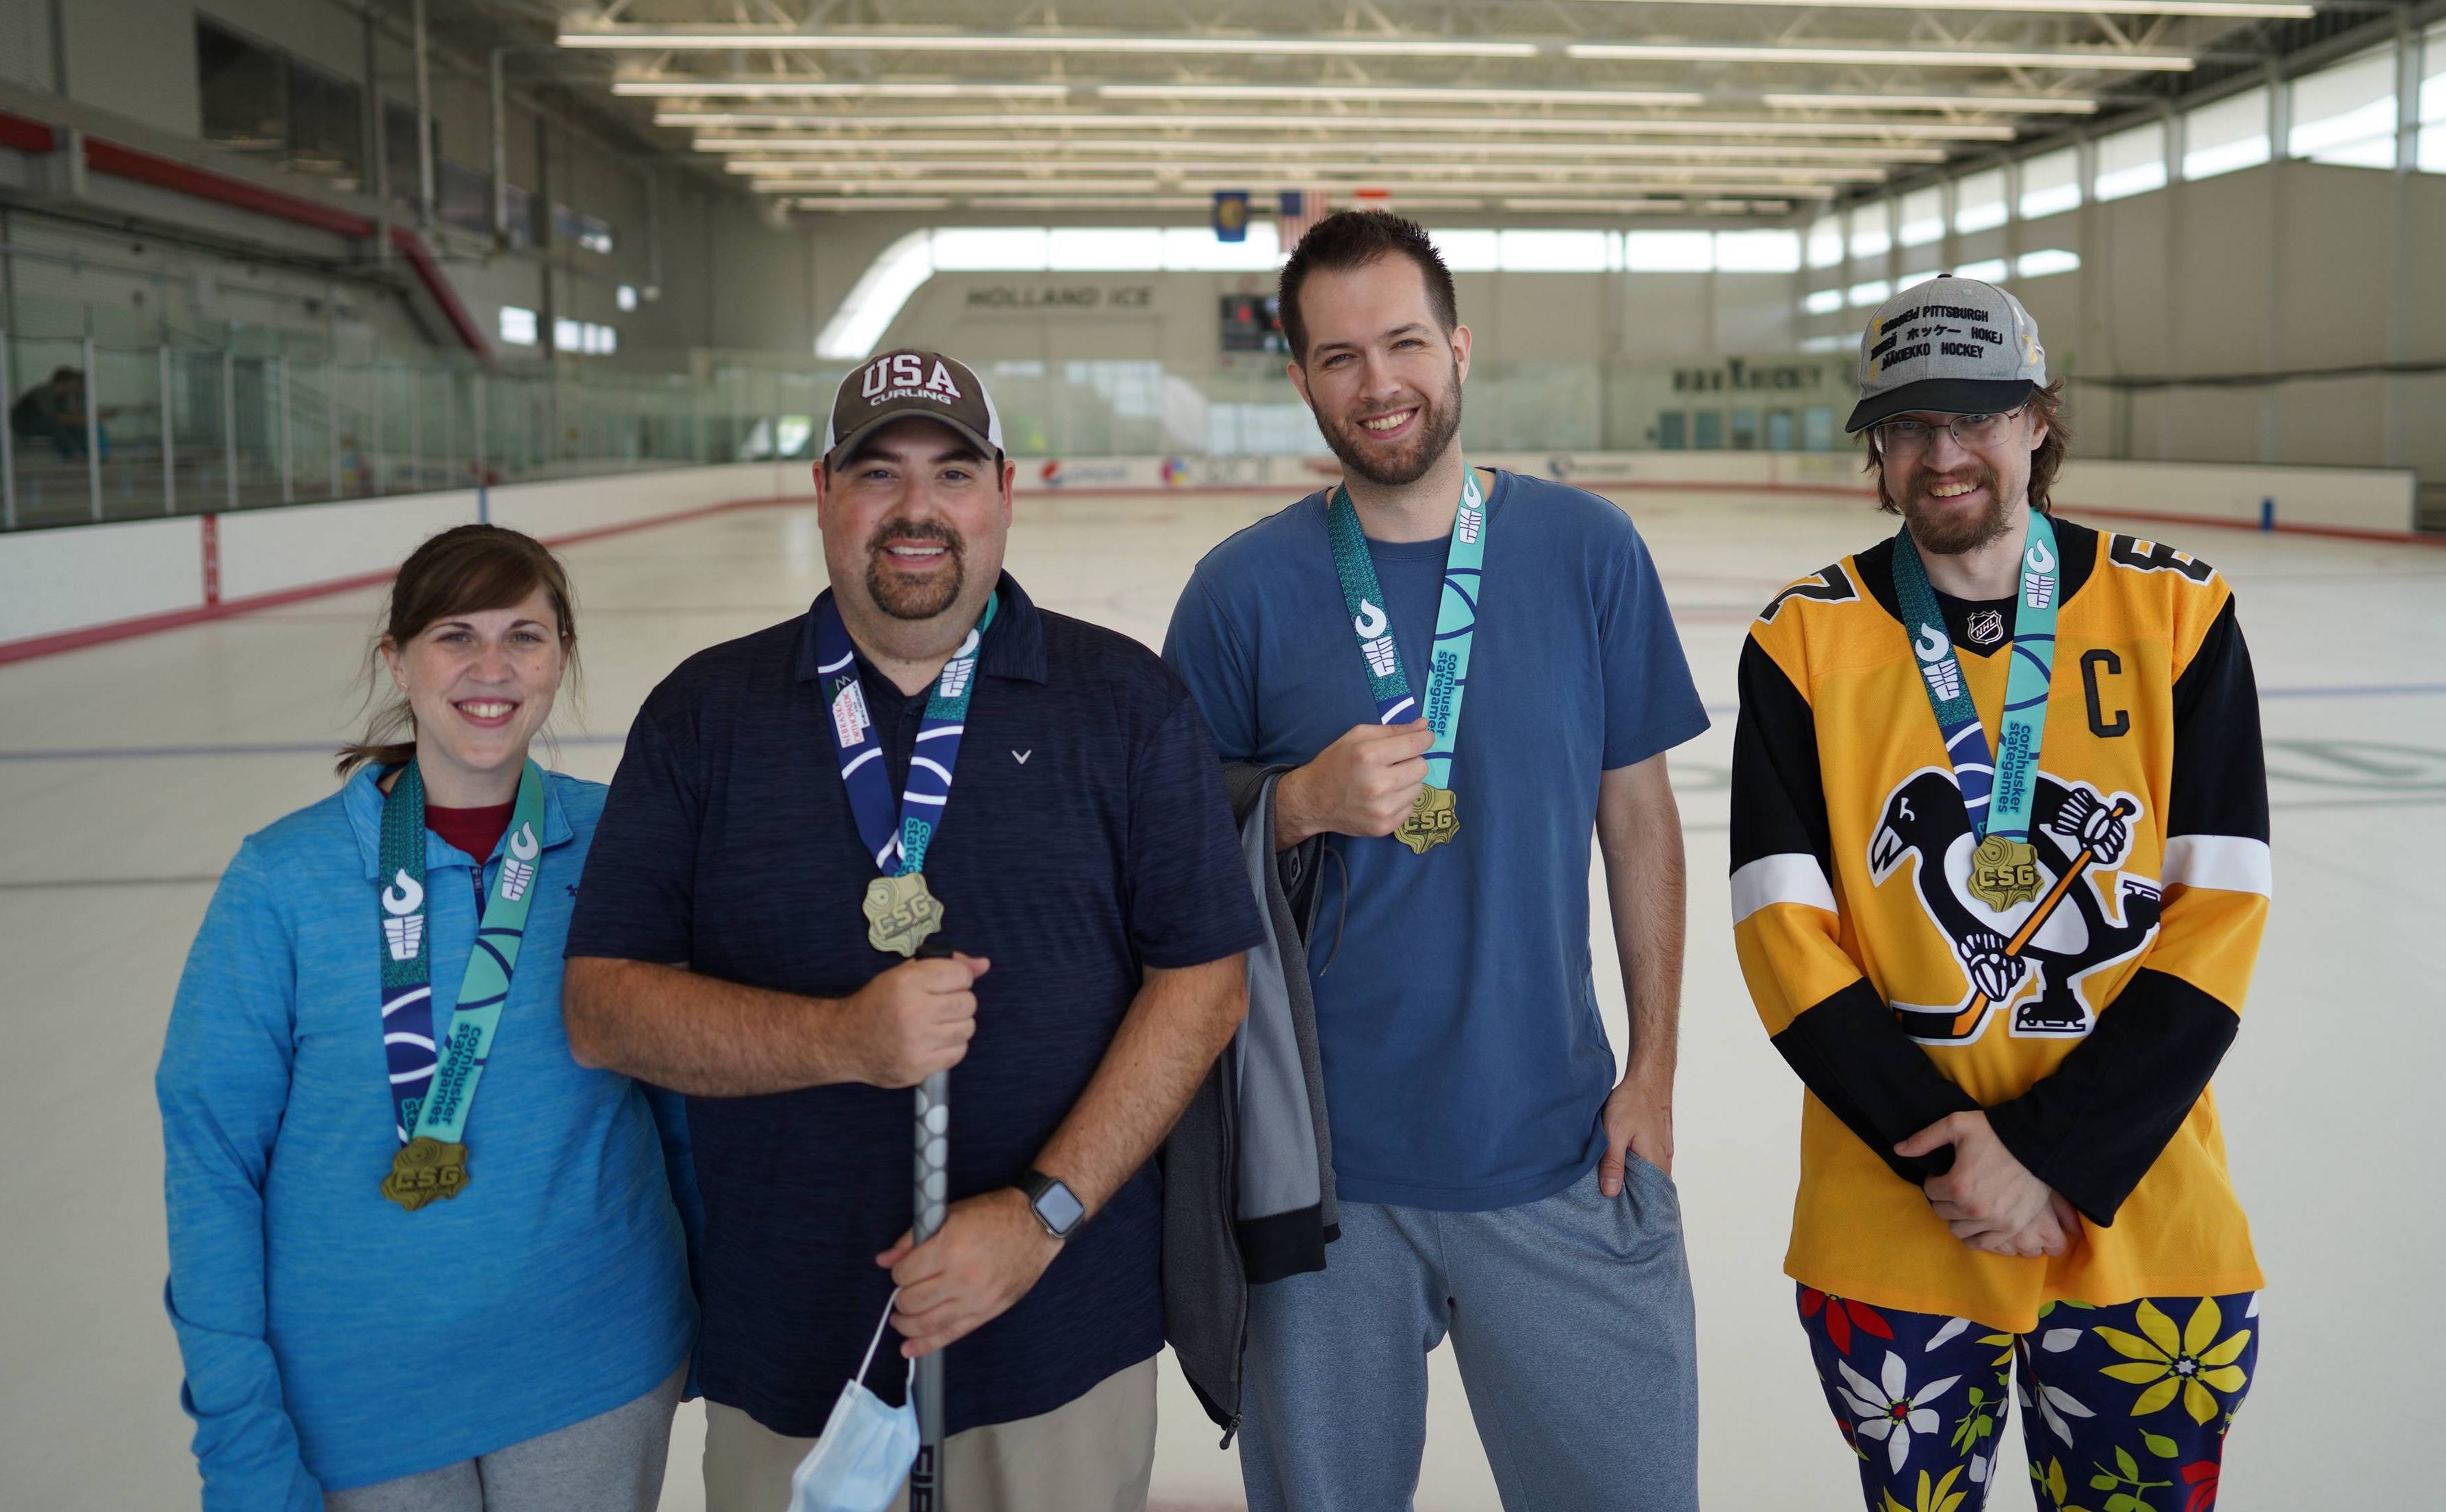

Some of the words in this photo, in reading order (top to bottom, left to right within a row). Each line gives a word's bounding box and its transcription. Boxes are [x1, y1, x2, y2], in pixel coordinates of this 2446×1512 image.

[966, 286, 1103, 308] HOLLAND
[1107, 286, 1153, 308] ICE
[1922, 305, 1989, 322] PITTSBURGH
[1907, 324, 1961, 341] ホッケー
[1971, 326, 2003, 345] HOKEJ
[1941, 342, 1984, 359] HOCKEY
[861, 353, 962, 399] USA
[870, 388, 951, 406] CURLING
[1976, 619, 1996, 637] NHL
[1437, 654, 1457, 735] cornhusker
[2080, 649, 2130, 738] C
[835, 701, 851, 746] NEBRASKA
[1998, 722, 2020, 813] stategames
[2009, 725, 2031, 813] cornhusker
[1404, 810, 1452, 831] CSG
[1979, 865, 2035, 887] CSG
[874, 894, 932, 937] CSG
[428, 1024, 470, 1125] stategames
[442, 1027, 482, 1126] cornhusker
[396, 1165, 461, 1189] CSG
